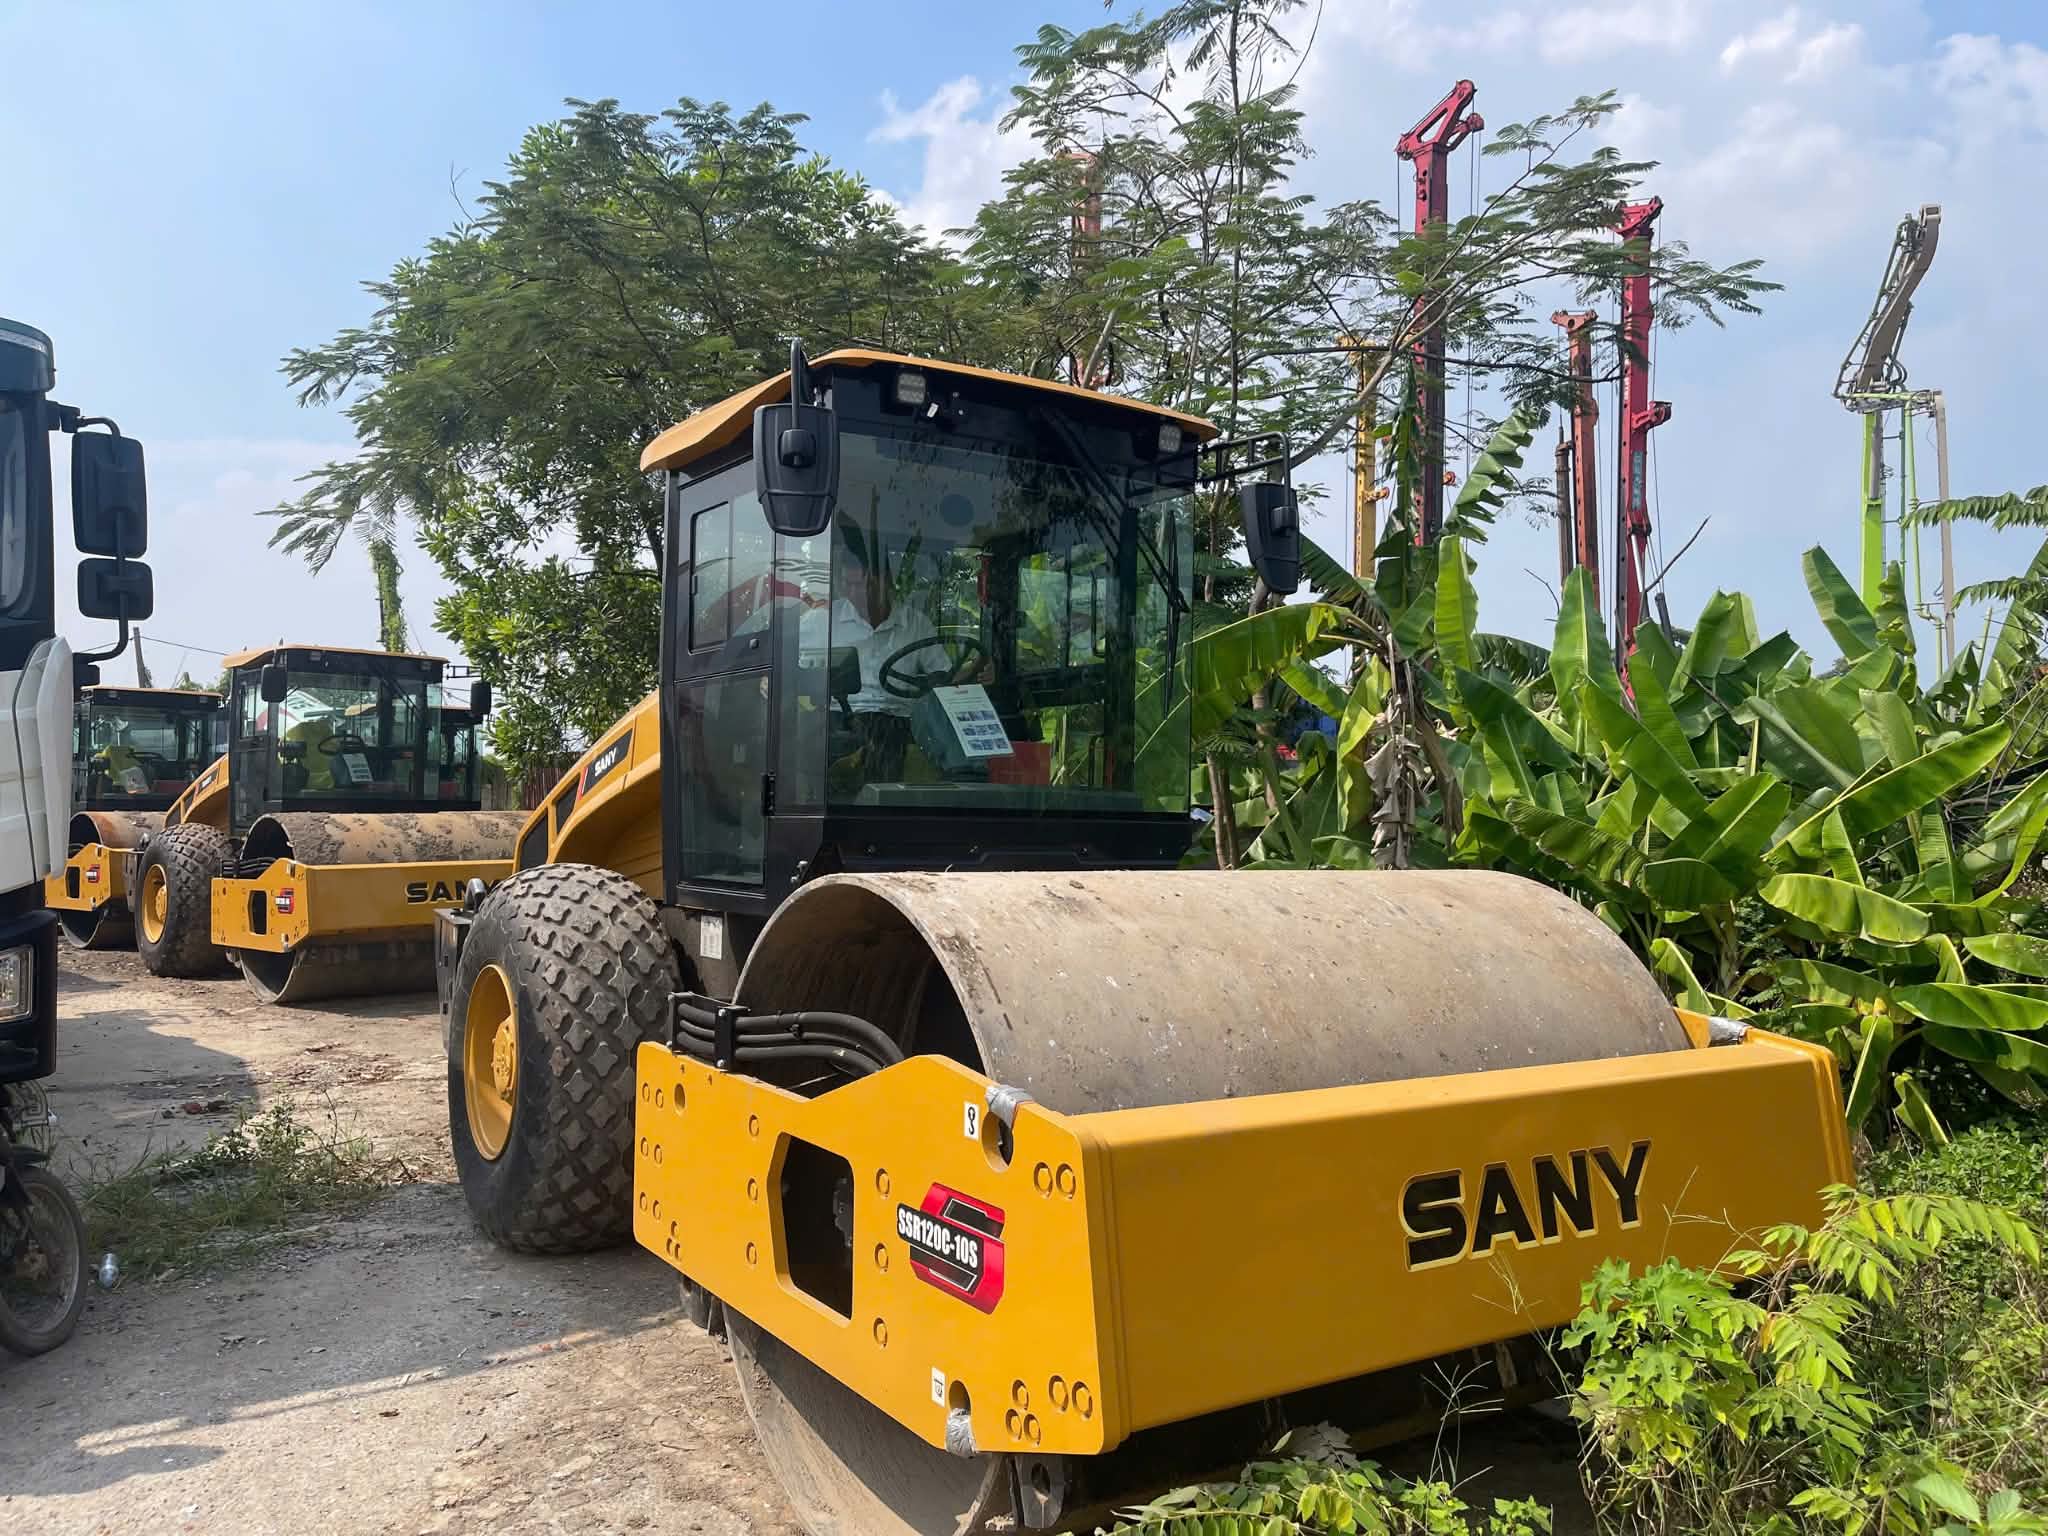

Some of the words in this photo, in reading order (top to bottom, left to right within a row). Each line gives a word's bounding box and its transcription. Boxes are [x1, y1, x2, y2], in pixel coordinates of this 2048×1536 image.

[594, 747, 617, 777] SANY
[1399, 1138, 1651, 1271] SANY
[898, 1207, 978, 1269] SSR120C-10S
